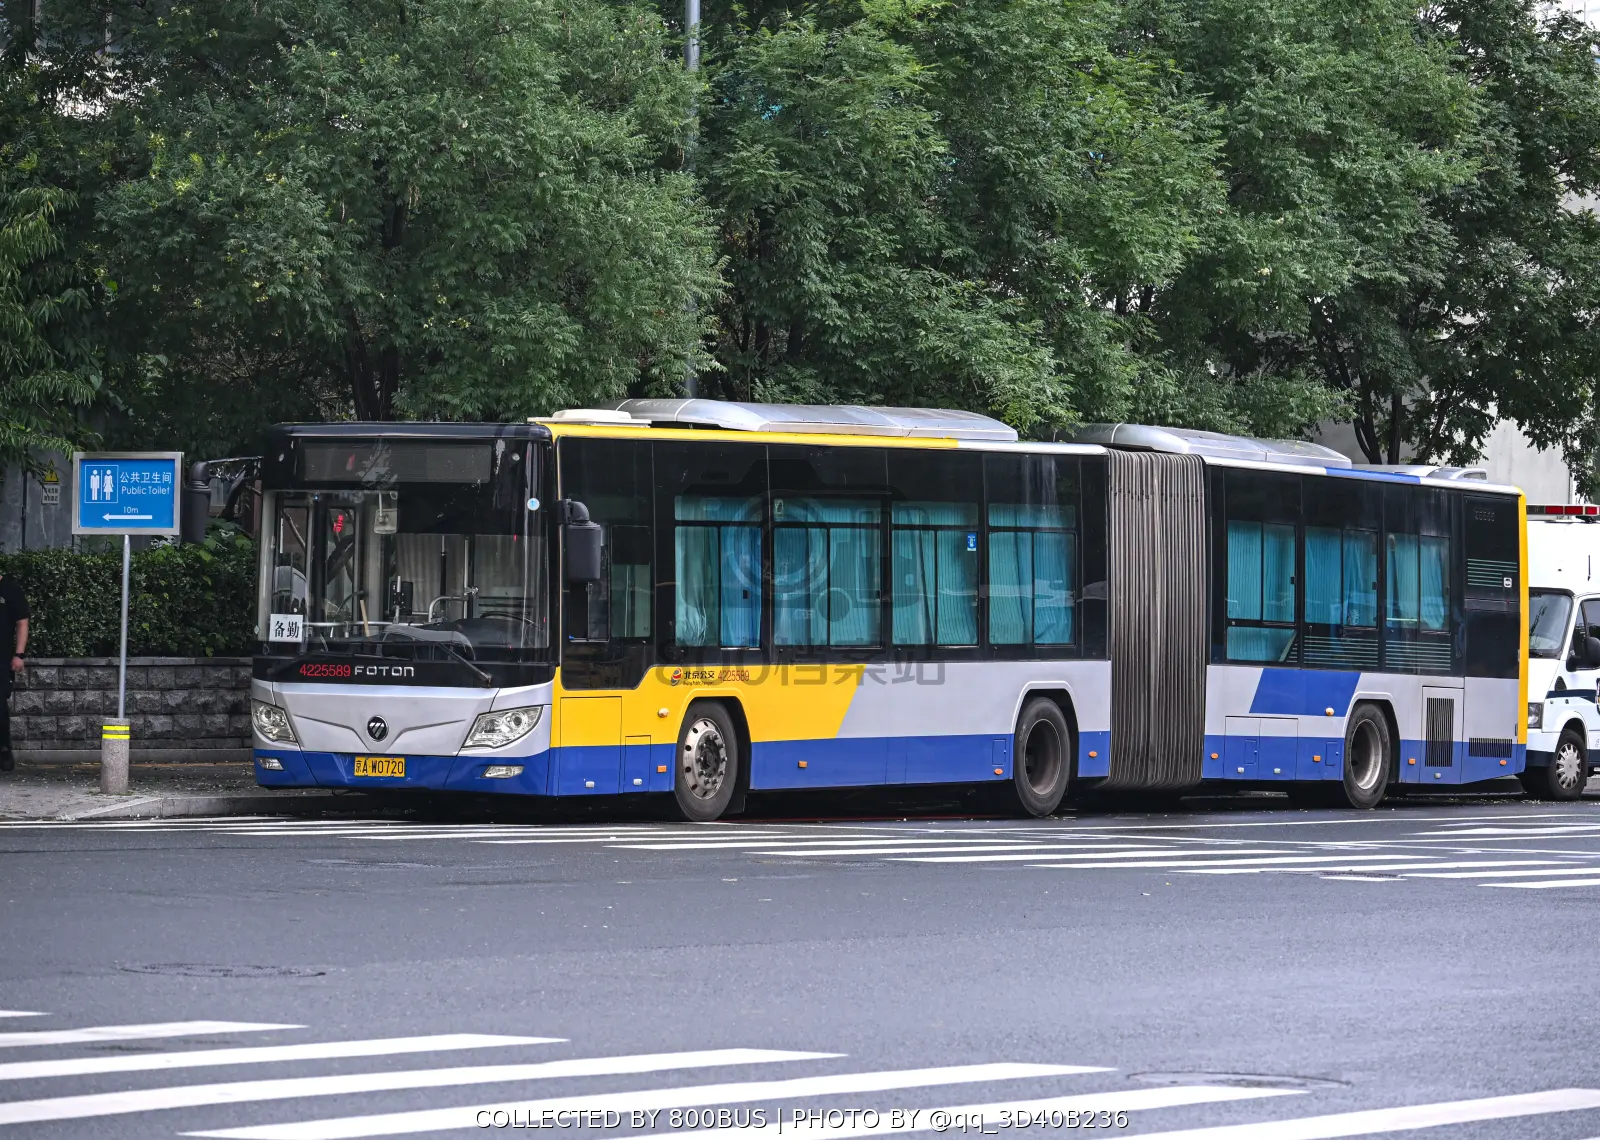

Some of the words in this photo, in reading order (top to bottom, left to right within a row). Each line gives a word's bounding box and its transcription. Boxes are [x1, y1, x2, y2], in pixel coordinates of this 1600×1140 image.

[119, 471, 172, 484] 公共卫生间
[121, 485, 147, 495] Public
[148, 485, 170, 495] Toilet
[123, 506, 139, 514] 10m
[274, 620, 300, 639] 备勤
[299, 663, 351, 677] 4225589
[354, 665, 415, 678] FOTON
[683, 670, 716, 680] 北京公交
[717, 669, 750, 682] 4225589
